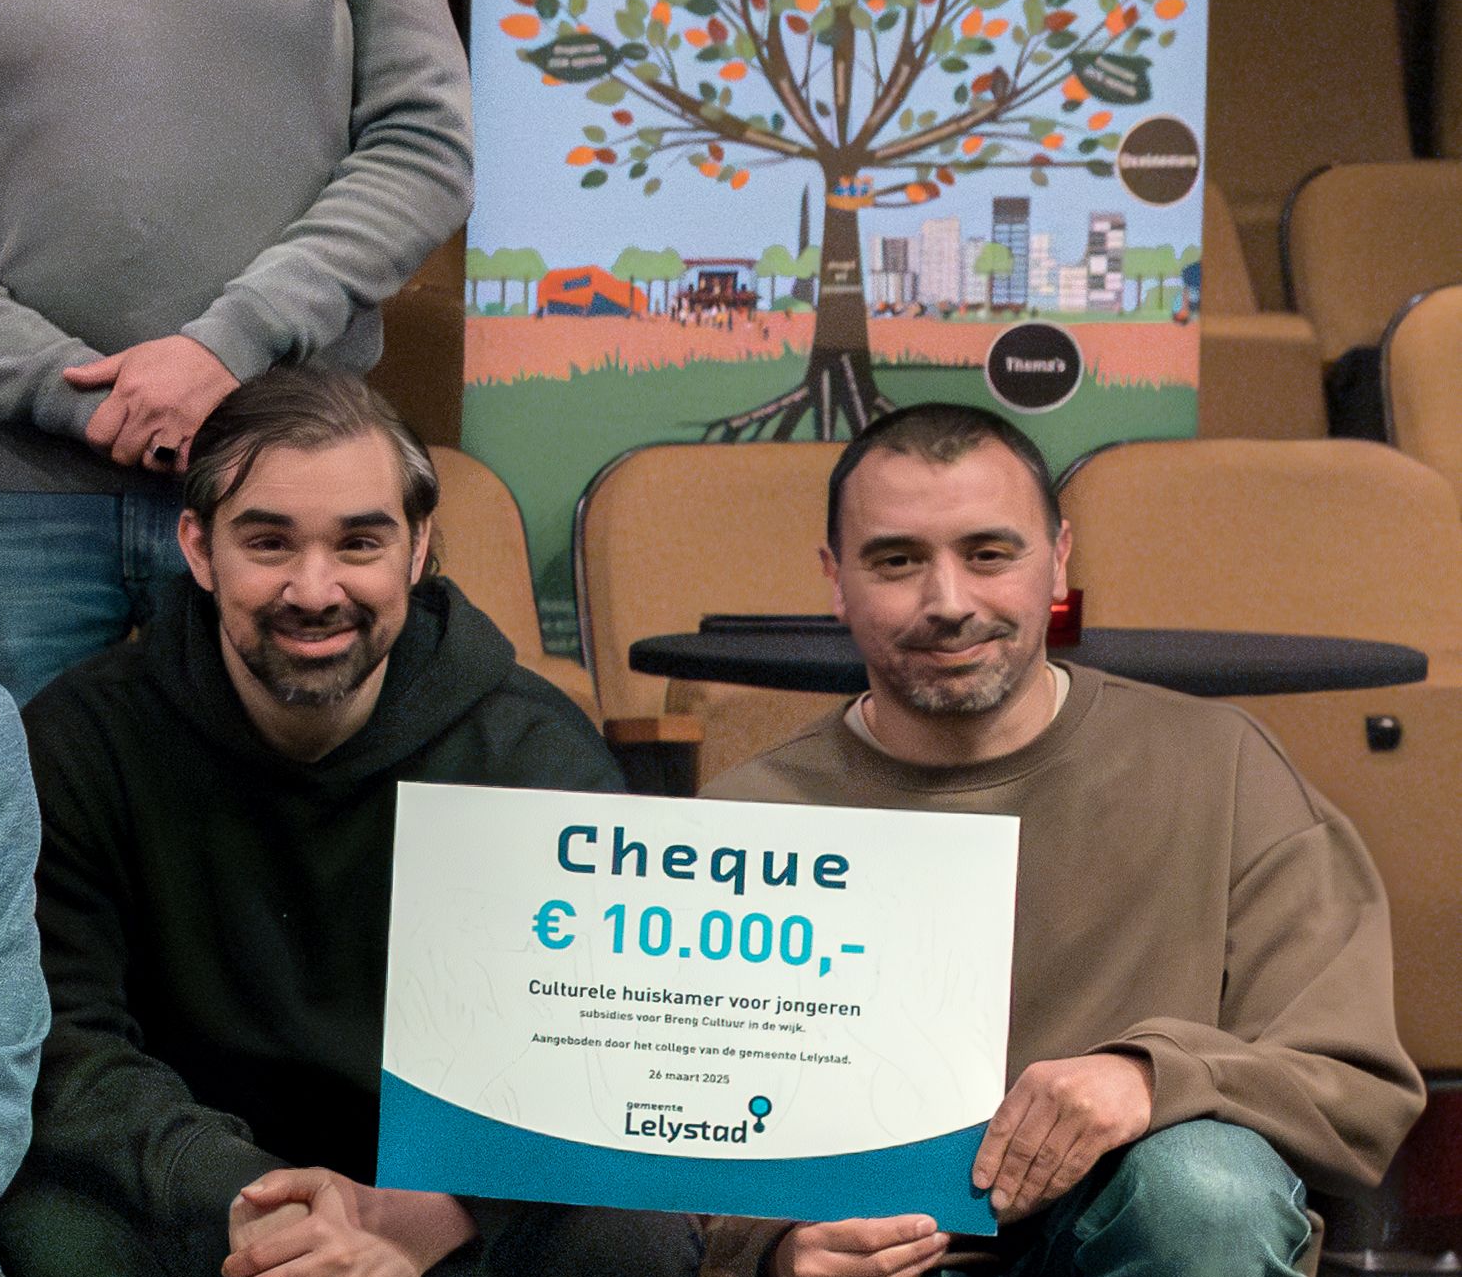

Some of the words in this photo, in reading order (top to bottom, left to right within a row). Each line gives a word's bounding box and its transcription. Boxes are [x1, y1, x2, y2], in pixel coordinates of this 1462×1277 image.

[557, 824, 850, 896] Cheque
[531, 899, 577, 951] €
[603, 903, 866, 978] 10.000,-
[528, 979, 617, 1000] Culturele
[622, 985, 725, 1008] huiskamer
[728, 996, 771, 1011] voor
[774, 995, 861, 1018] jongeren
[530, 1032, 602, 1047] Aangeboden
[604, 1037, 631, 1049] door
[633, 1040, 653, 1051] het
[654, 1042, 697, 1056] college
[698, 1046, 720, 1055] van
[721, 1046, 736, 1057] de
[738, 1049, 797, 1061] gemeente
[648, 1068, 663, 1080] 26
[665, 1072, 700, 1083] maart
[702, 1072, 730, 1085] 2025
[625, 1101, 684, 1113] gemeente
[624, 1111, 748, 1144] Lelystad
